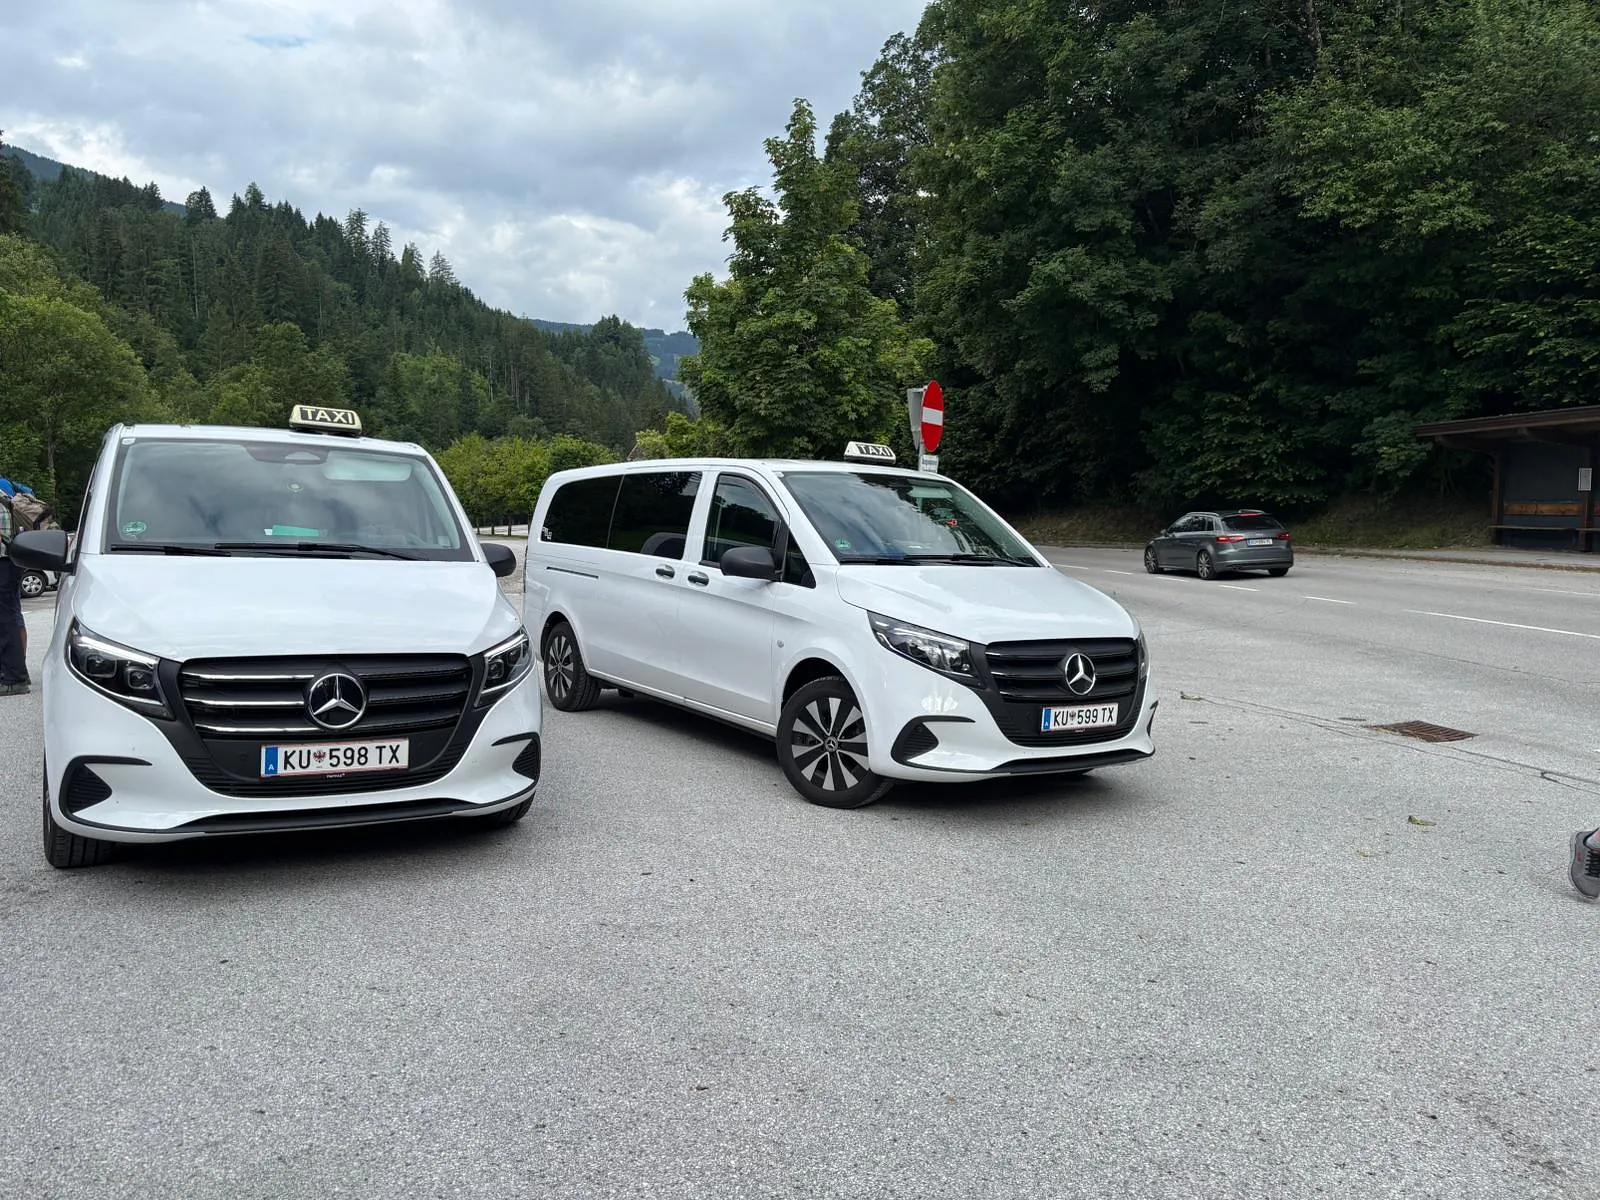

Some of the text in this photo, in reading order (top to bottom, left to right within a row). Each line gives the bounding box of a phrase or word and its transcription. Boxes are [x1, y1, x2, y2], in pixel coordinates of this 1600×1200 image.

[302, 407, 353, 424] TAXI
[860, 444, 891, 457] TAXI
[1054, 706, 1115, 727] KU 599 TX
[283, 744, 401, 771] KU 598 TX
[268, 763, 275, 771] A
